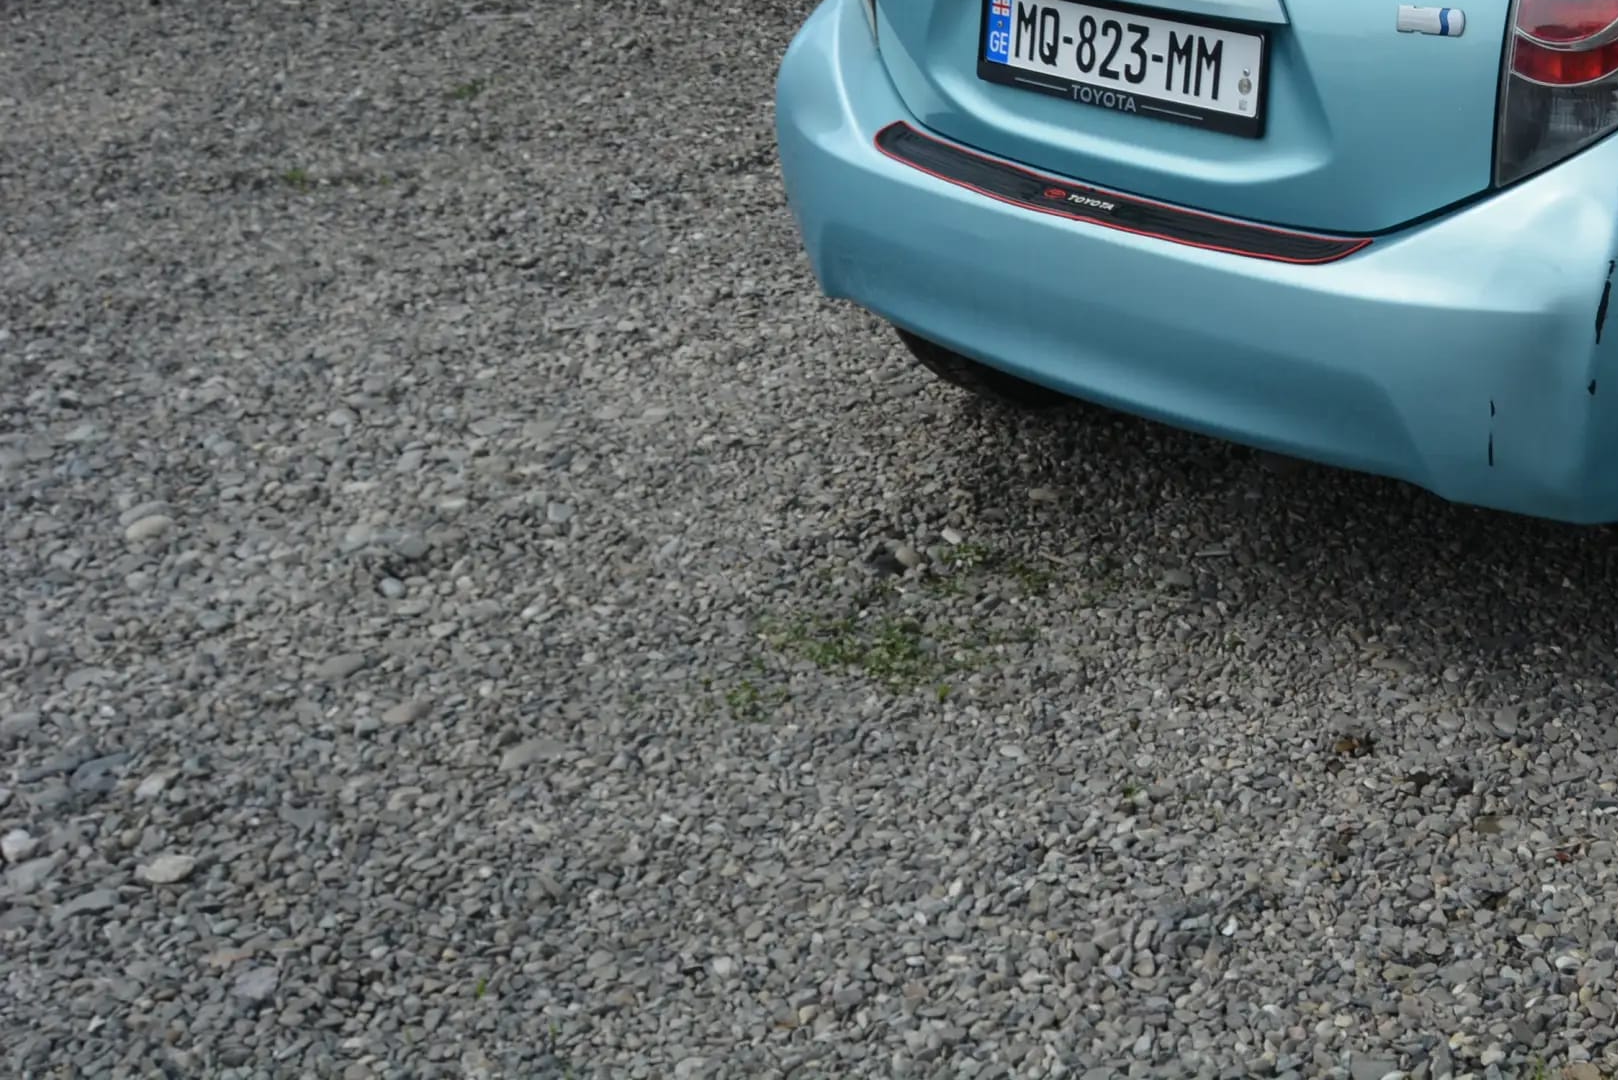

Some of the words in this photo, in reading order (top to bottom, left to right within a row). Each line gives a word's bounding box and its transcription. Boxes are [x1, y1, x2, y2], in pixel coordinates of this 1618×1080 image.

[990, 30, 1009, 54] GE
[1014, 1, 1224, 101] MQ-823-MM
[1071, 84, 1137, 113] TOYOTA
[1067, 194, 1115, 211] TOYOTA
